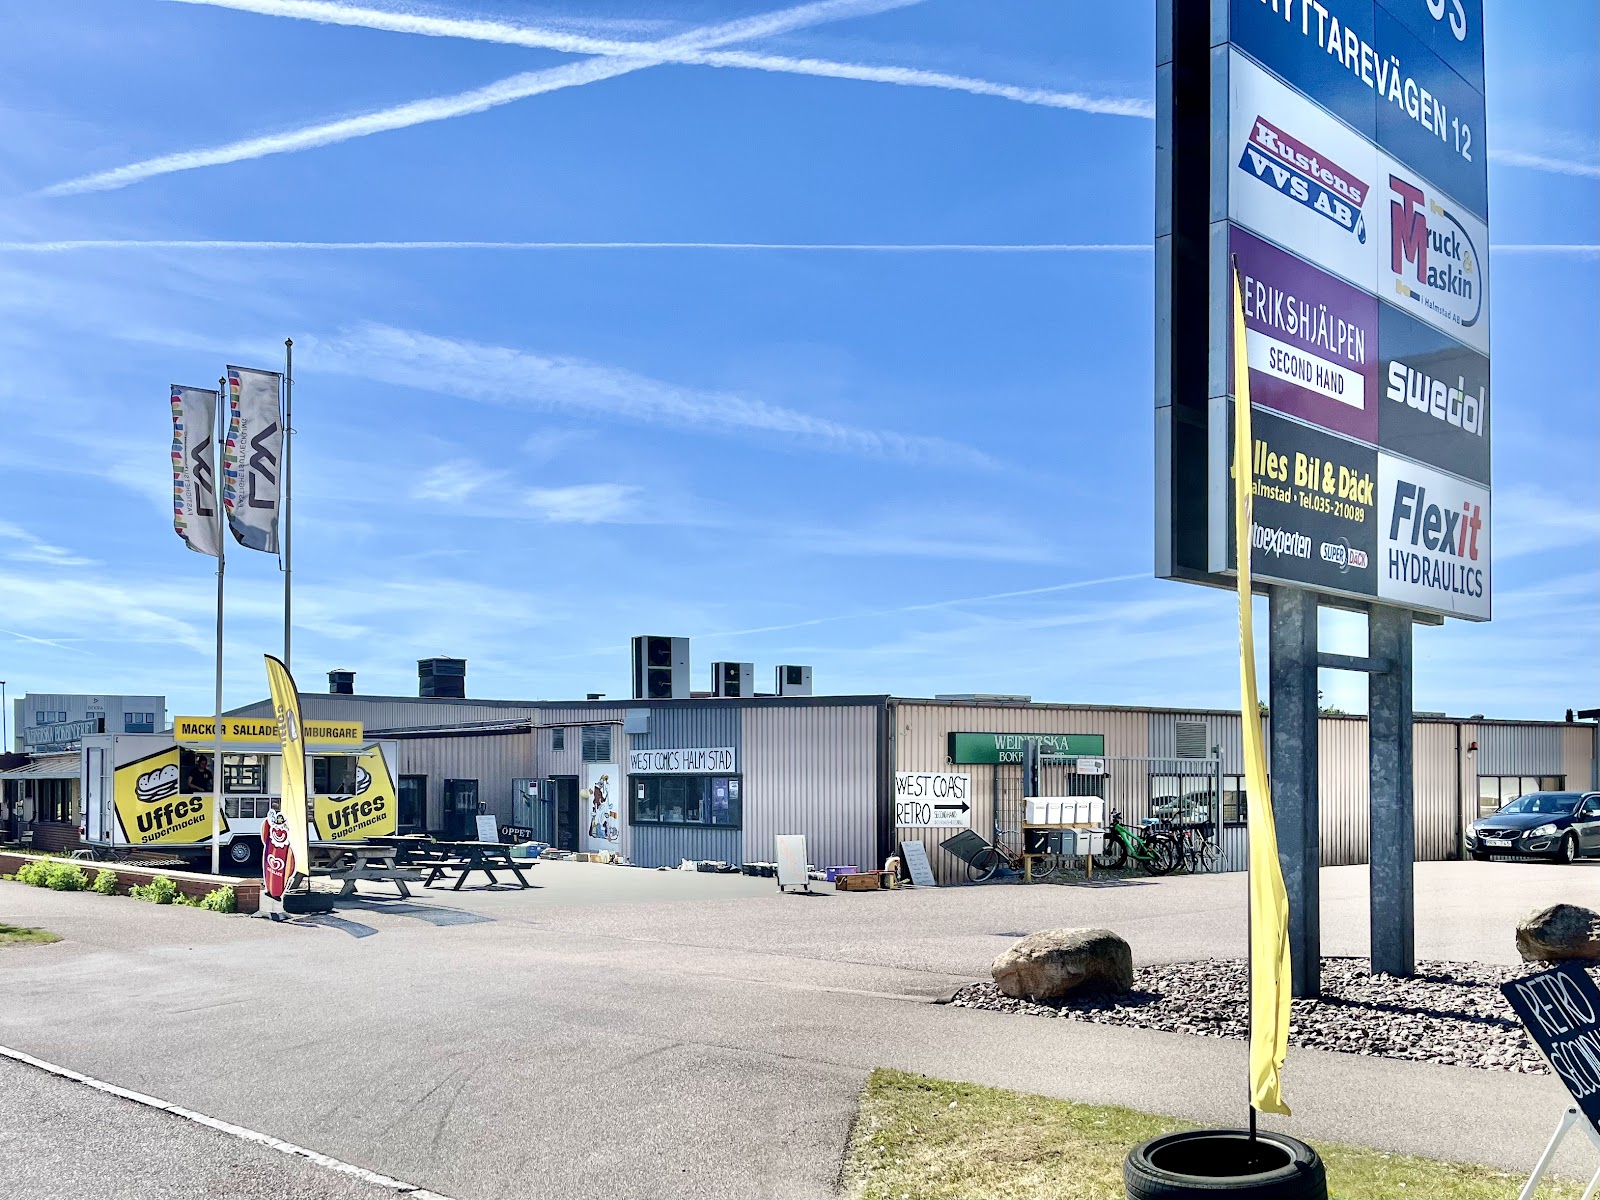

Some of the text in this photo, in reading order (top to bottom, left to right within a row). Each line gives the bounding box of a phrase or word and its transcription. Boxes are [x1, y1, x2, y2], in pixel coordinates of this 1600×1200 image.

[1260, 0, 1472, 163] YTTAREVÄGEN 12
[1256, 121, 1362, 203] Kustens
[1247, 147, 1353, 228] VVS AB
[1245, 275, 1365, 365] ERIKSHJÄLPEN
[1424, 297, 1451, 319] Halmstad
[1452, 312, 1461, 325] AB
[1269, 346, 1344, 395] SECOND HAND
[1387, 360, 1486, 437] swedol
[1251, 479, 1291, 503] almstad
[1294, 452, 1320, 491] Bil
[1322, 461, 1336, 495] &
[1338, 465, 1374, 506] Däck
[1251, 521, 1312, 559] toexperten
[1389, 479, 1481, 561] Flexit
[1323, 545, 1344, 562] SUPER
[1389, 547, 1483, 598] HYDRAULICS
[182, 723, 357, 739] MACKR SALLADE MBURGARE
[631, 752, 653, 771] WEST
[654, 751, 679, 771] COMICS
[895, 775, 968, 799] WEST COAST
[136, 796, 203, 833] Uffes
[327, 796, 385, 830] Uffes
[896, 801, 931, 825] RETRO
[1515, 971, 1596, 1037] RETRO
